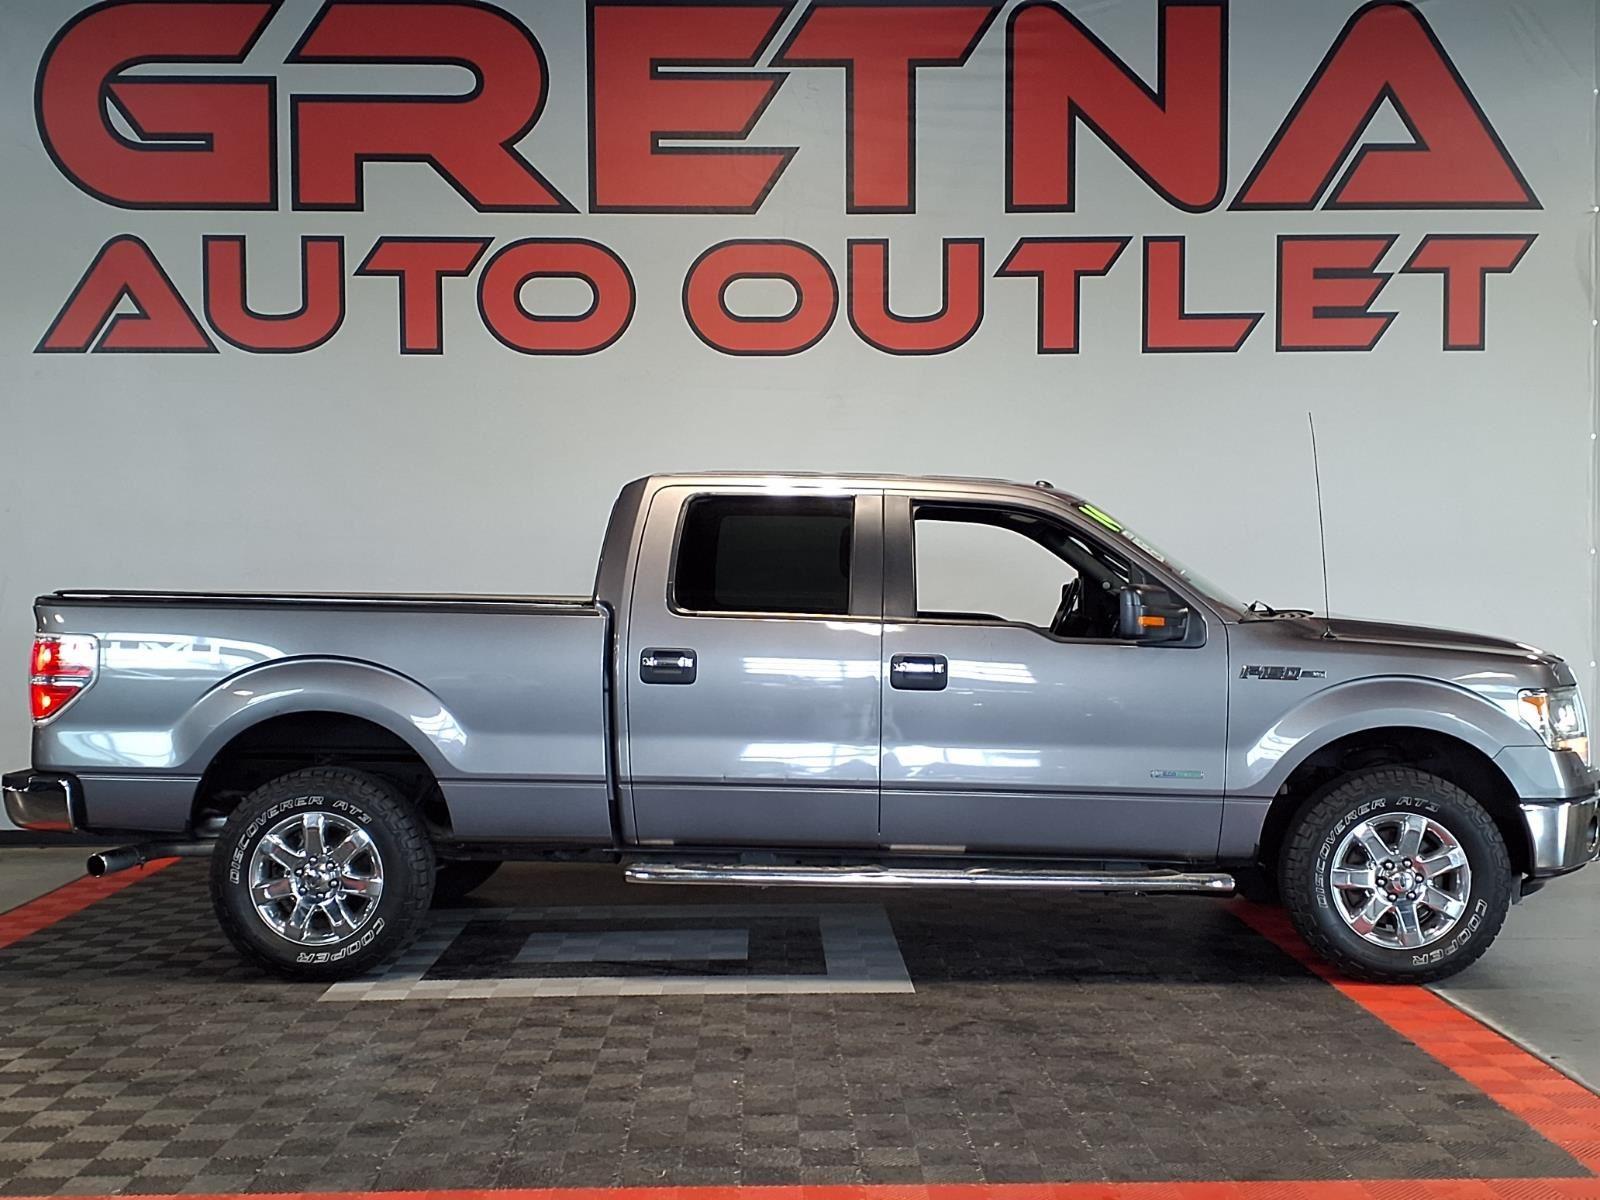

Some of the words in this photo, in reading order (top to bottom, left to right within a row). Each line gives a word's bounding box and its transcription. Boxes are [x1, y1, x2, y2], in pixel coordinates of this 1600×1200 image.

[34, 0, 1544, 214] GRETNA
[33, 233, 636, 356] AUTO
[682, 234, 1540, 357] OUTLET
[229, 796, 324, 885] DISCOVERER
[332, 799, 373, 825] AT3
[1314, 797, 1387, 909] DISCOVERER
[1395, 796, 1441, 813] AT3
[296, 917, 386, 964] COOPER
[1412, 899, 1488, 966] COOPER
